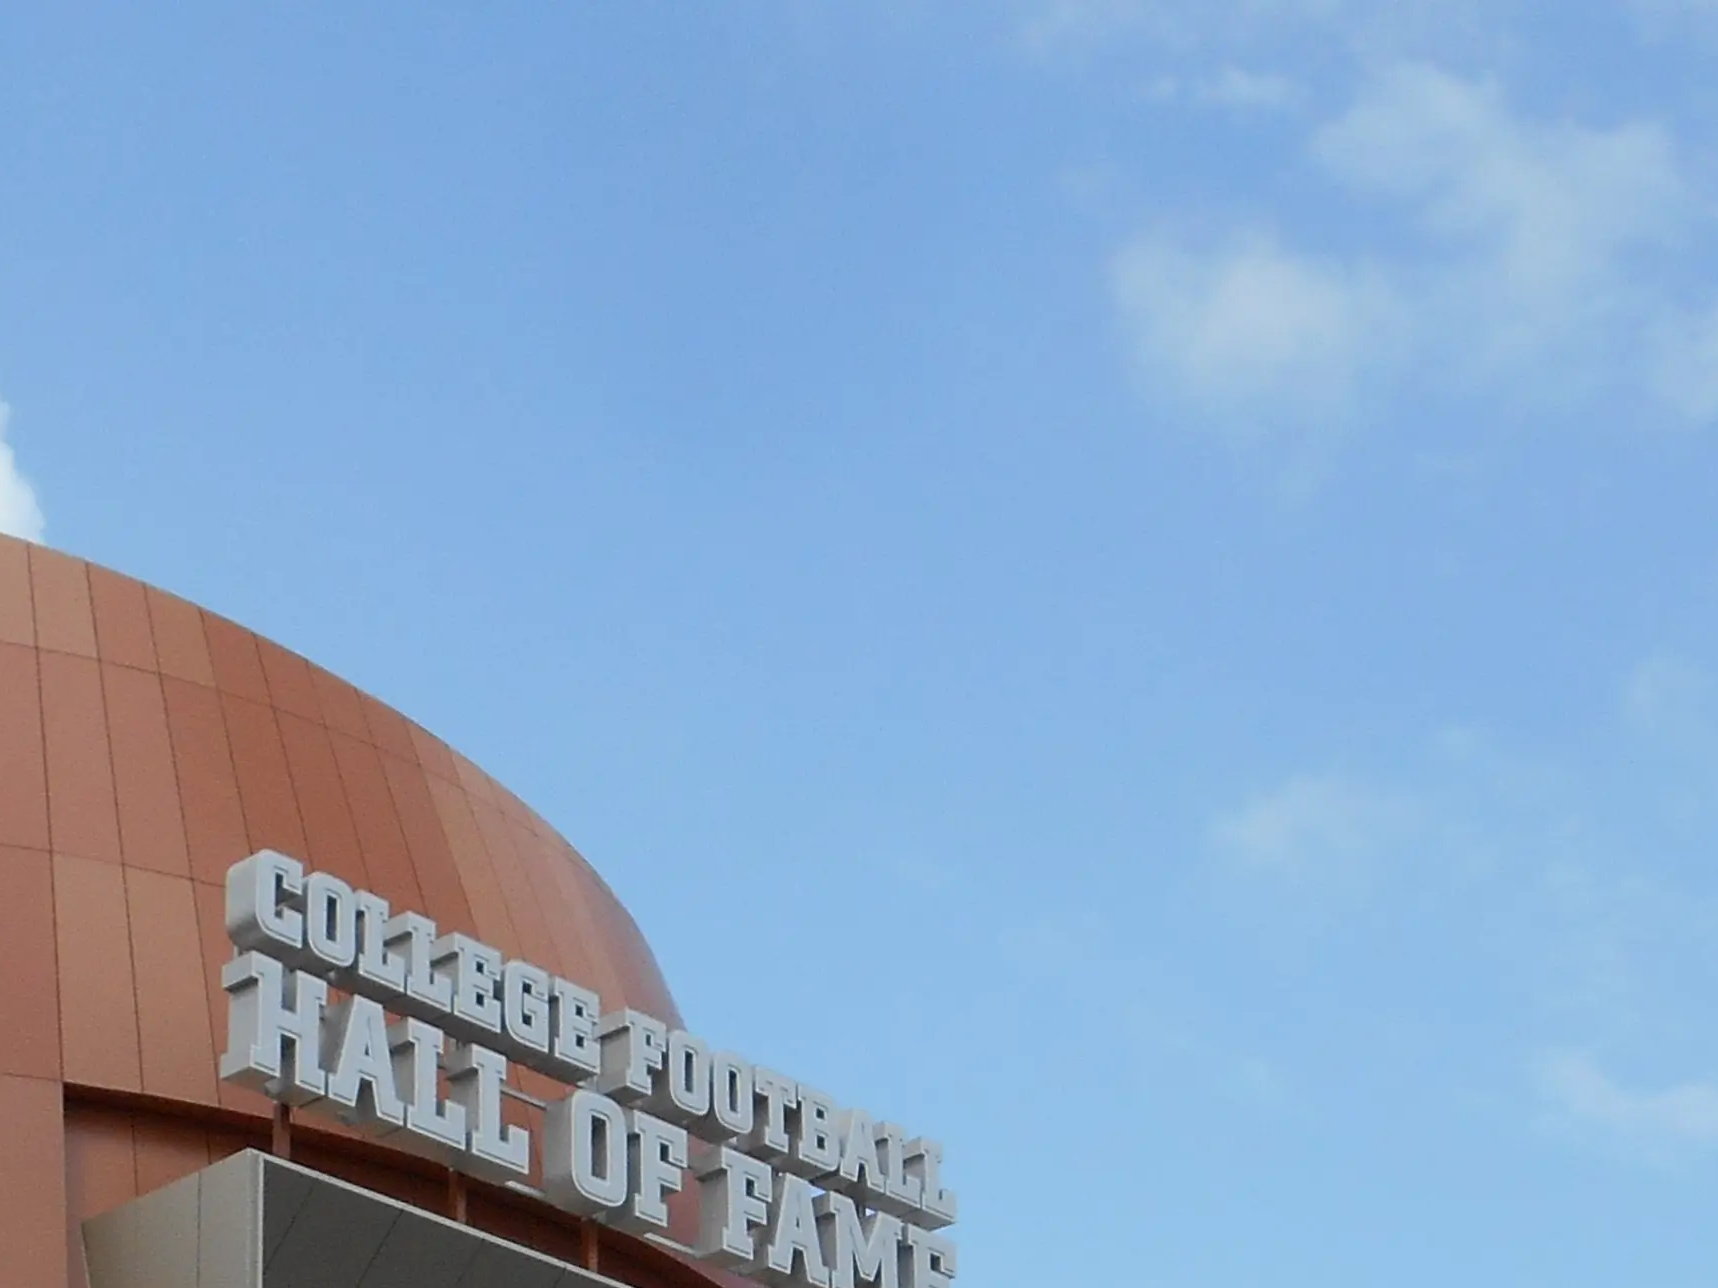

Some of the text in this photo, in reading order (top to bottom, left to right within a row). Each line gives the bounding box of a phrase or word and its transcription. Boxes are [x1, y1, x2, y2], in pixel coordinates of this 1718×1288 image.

[223, 952, 529, 1180] HALL
[553, 1088, 688, 1230] OF
[231, 850, 957, 1232] COLLEGE FOOTBALL
